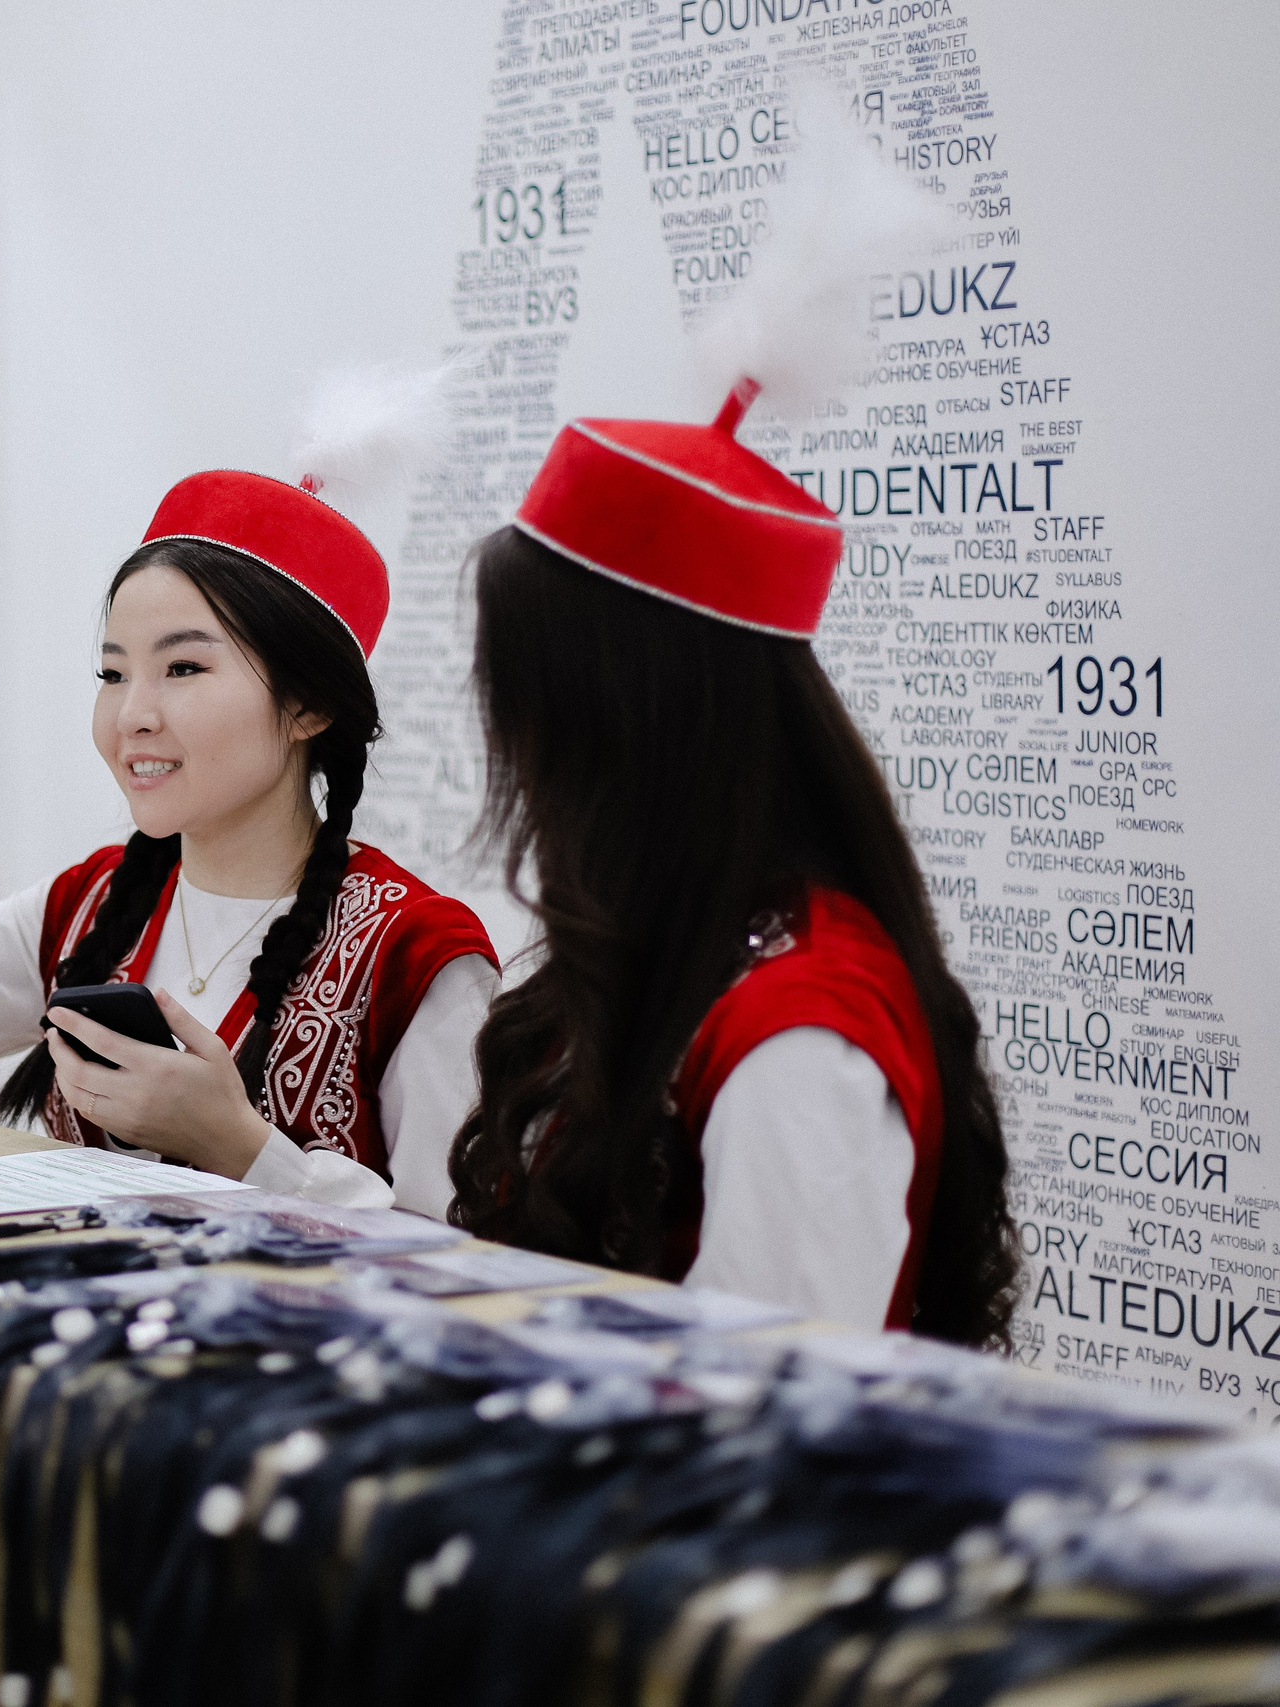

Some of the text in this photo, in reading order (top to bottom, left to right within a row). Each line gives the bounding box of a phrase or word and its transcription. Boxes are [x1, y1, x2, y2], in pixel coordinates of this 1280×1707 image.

[797, 0, 953, 42] ЖЕЛЕЗНАЯ ДОРОГА
[927, 17, 968, 34] BACHELOR
[538, 27, 620, 64] АЛМАТЫ
[871, 33, 968, 59] ТЕСТ ФАКУЛЬТЕТ
[942, 48, 976, 68] ЛЕТО
[623, 60, 712, 93] СЕМИНАР
[934, 66, 981, 84] ГЕОГРАФИЯ
[912, 78, 981, 101] АКТОВЫЙ ЗАЛ
[939, 100, 990, 117] DORMITORY
[908, 123, 964, 142] БИБЛИОТЕКА
[644, 125, 740, 172] HELLO
[894, 133, 998, 171] HISTORY
[472, 180, 568, 247] 1931
[949, 197, 1012, 221] РУЗЬЯ
[870, 260, 1018, 321] EDUKZ
[525, 285, 580, 326] ВУЗ
[936, 356, 1023, 381] ОБУЧЕНИЕ
[1000, 377, 1072, 406] STAFF
[866, 403, 927, 429] ПОЕЗД
[936, 397, 991, 414] ОТБАСЫ
[1020, 419, 1084, 437] THE BEST
[800, 429, 879, 458] ДИПЛОМ
[891, 428, 1005, 460] АКАДЕМИЯ
[1021, 441, 1078, 457] ШЫМКЕНТ
[790, 458, 1064, 517] TUDENTALT
[910, 520, 964, 537] ОТБАСЫ
[1034, 516, 1105, 542] STAFF
[955, 538, 1018, 564] ПОЕЗД
[1026, 547, 1113, 563] #STUDENTALT
[930, 572, 1039, 599] ALEDUKZ
[1055, 571, 1122, 588] SYLLABUS
[1046, 599, 1122, 620] ФИЗИКА
[887, 647, 997, 669] TECHNOLOGY
[973, 671, 1043, 688] СТУДЕНТЫ
[1047, 654, 1163, 718] 1931
[981, 692, 1044, 711] LIBRARY
[890, 704, 975, 726] ACADEMY
[901, 728, 1008, 749] LABORATORY
[1075, 730, 1158, 756] JUNIOR
[876, 753, 959, 791] TUDY
[1099, 761, 1138, 783] GPA
[944, 790, 1067, 821] LOGISTICS
[1069, 784, 1136, 813] ПОЕЗД
[1010, 824, 1105, 852] БАКАЛАВР
[1116, 818, 1185, 835] HOMEWORK
[1005, 850, 1186, 882] СТУДЕНЧЕСКАЯ ЖИЗНЬ
[1057, 887, 1121, 906] LOGISTICS
[1127, 883, 1195, 915] ПОЕЗД
[960, 901, 1051, 929] БАКАЛАВР
[969, 924, 1058, 955] FRIENDS
[1067, 907, 1194, 955] СӘЛЕМ
[997, 967, 1118, 994] ТРУДОУСТРОЙСТВА
[1061, 950, 1186, 986] АКАДЕМИЯ
[1081, 992, 1150, 1017] CHINESE
[1143, 986, 1214, 1005] HOMEWORK
[996, 999, 1112, 1050] HELLO
[1165, 1007, 1225, 1023] МАТЕМАТИКА
[1131, 1022, 1185, 1041] СЕМИНАР
[1195, 1030, 1242, 1048] USEFUL
[1120, 1038, 1240, 1068] STUDY ENGLISH
[1005, 1039, 1237, 1101] GOVERNMENT
[1176, 1101, 1250, 1127] ДИПЛОМ
[1151, 1120, 1261, 1154] EDUCATION
[1069, 1132, 1227, 1194] СЕССИЯ
[1033, 1195, 1103, 1227] ЖИЗНЬ
[1161, 1196, 1261, 1230] ОБУЧЕНИЕ
[1233, 1193, 1280, 1212] КАФЕДРА
[1210, 1232, 1266, 1253] АКТОВЫЙ
[1093, 1251, 1234, 1296] МАГИСТРАТУРА
[1210, 1257, 1280, 1281] ТЕХНОЛОГ
[1034, 1265, 1280, 1361] ALTEDUKZ
[1057, 1333, 1129, 1370] STAFF
[1135, 1345, 1192, 1372] АТЫРАУ
[1199, 1366, 1241, 1397] ВУЗ
